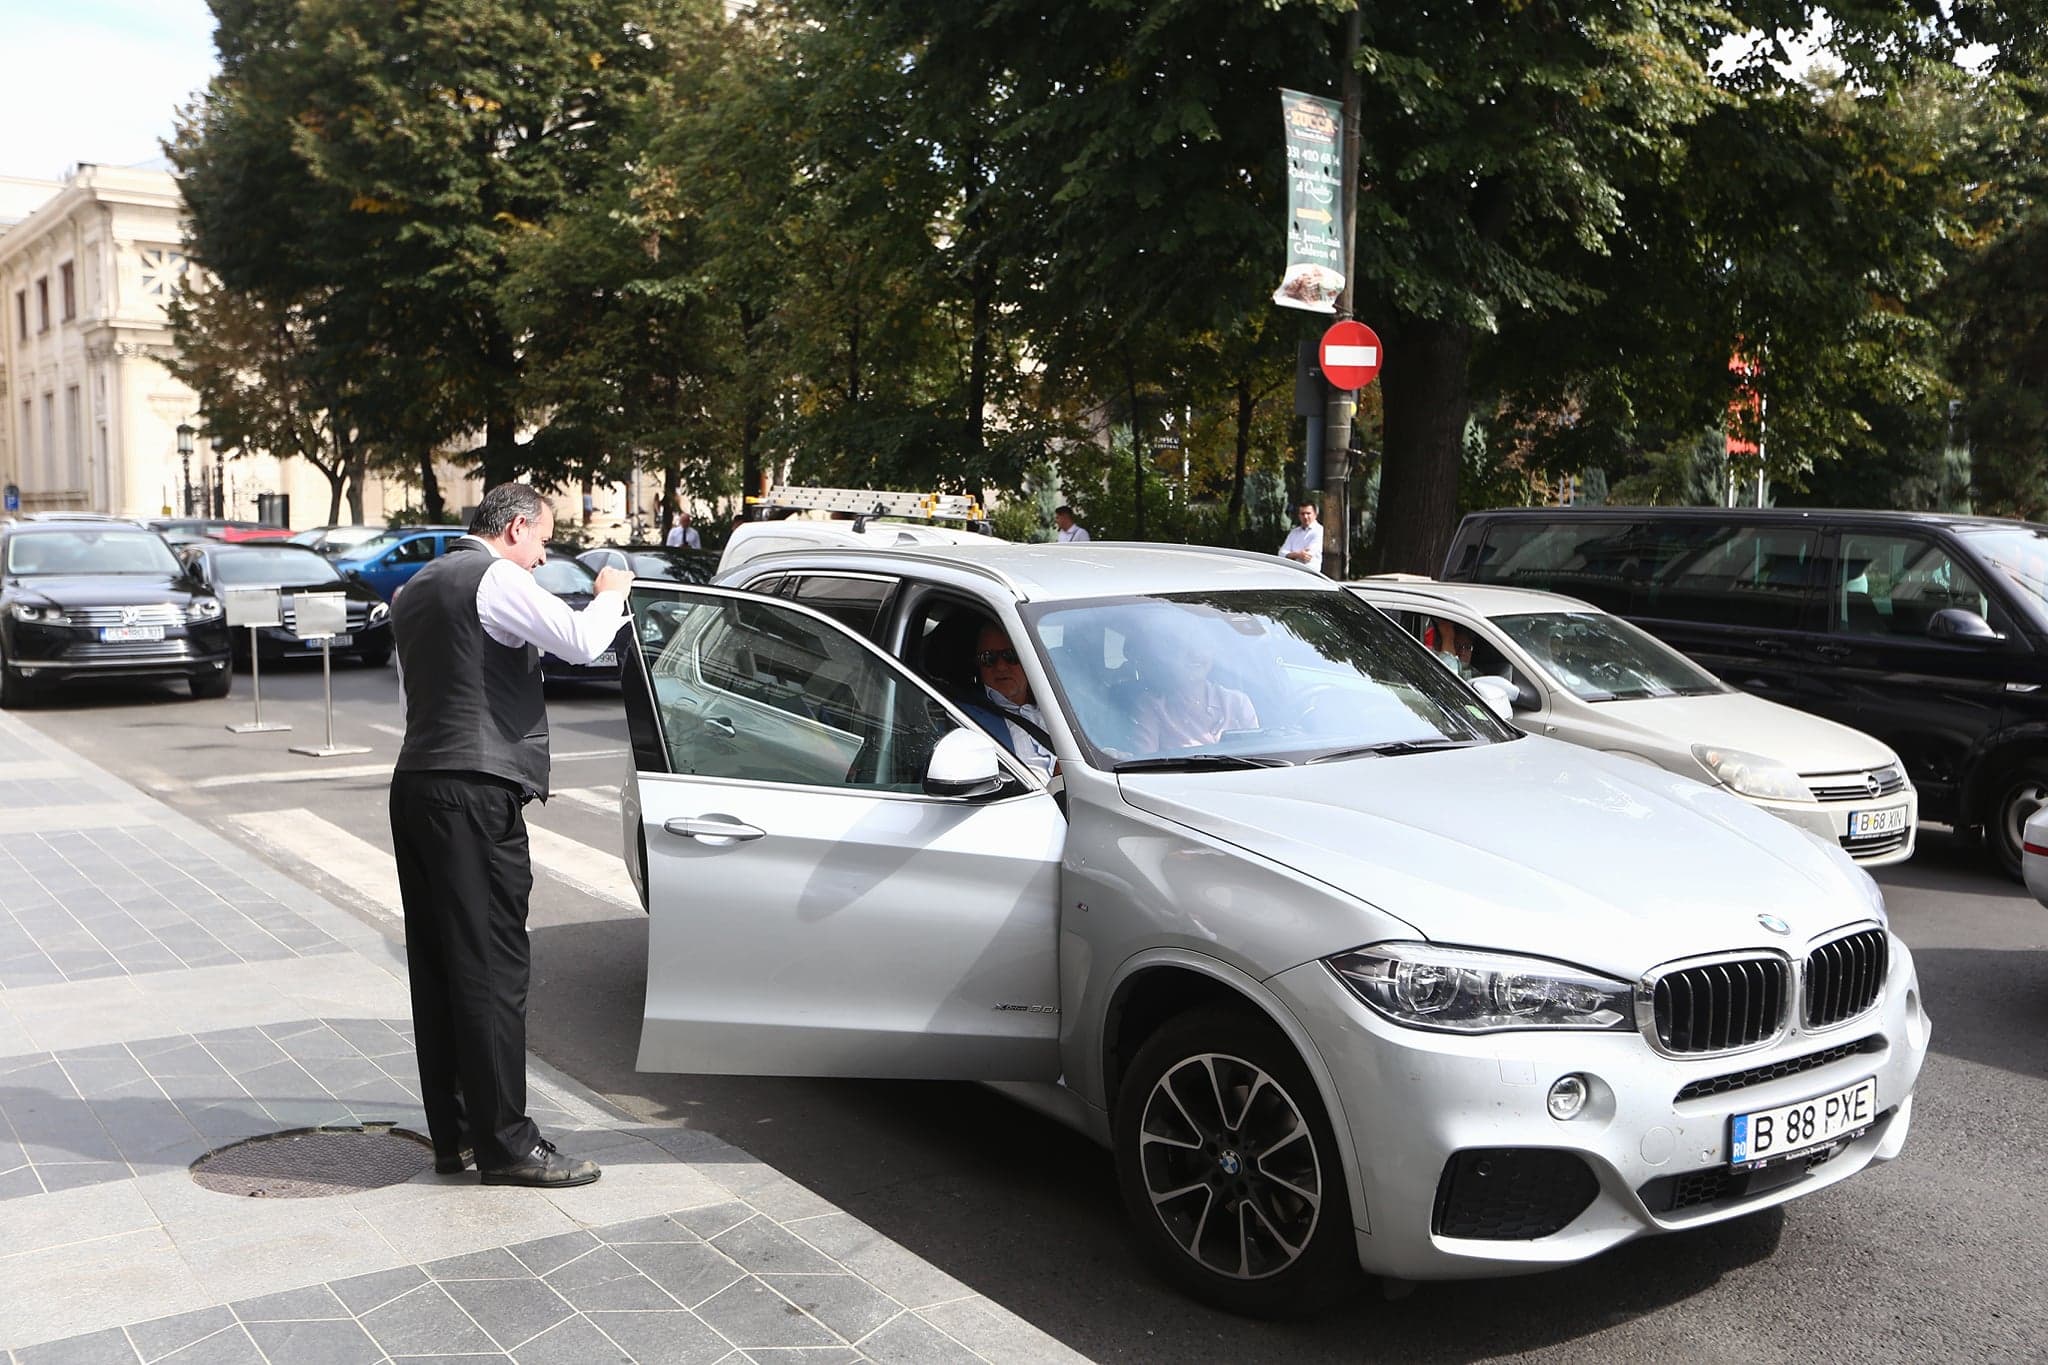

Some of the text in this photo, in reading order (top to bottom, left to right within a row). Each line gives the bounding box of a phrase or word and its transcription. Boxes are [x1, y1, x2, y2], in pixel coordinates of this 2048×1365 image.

[1861, 814, 1870, 831] B
[1873, 812, 1886, 830] 68
[1755, 1115, 1773, 1153] B
[1786, 1106, 1815, 1144] 88
[1824, 1085, 1869, 1134] PXE
[1733, 1142, 1746, 1157] RO
